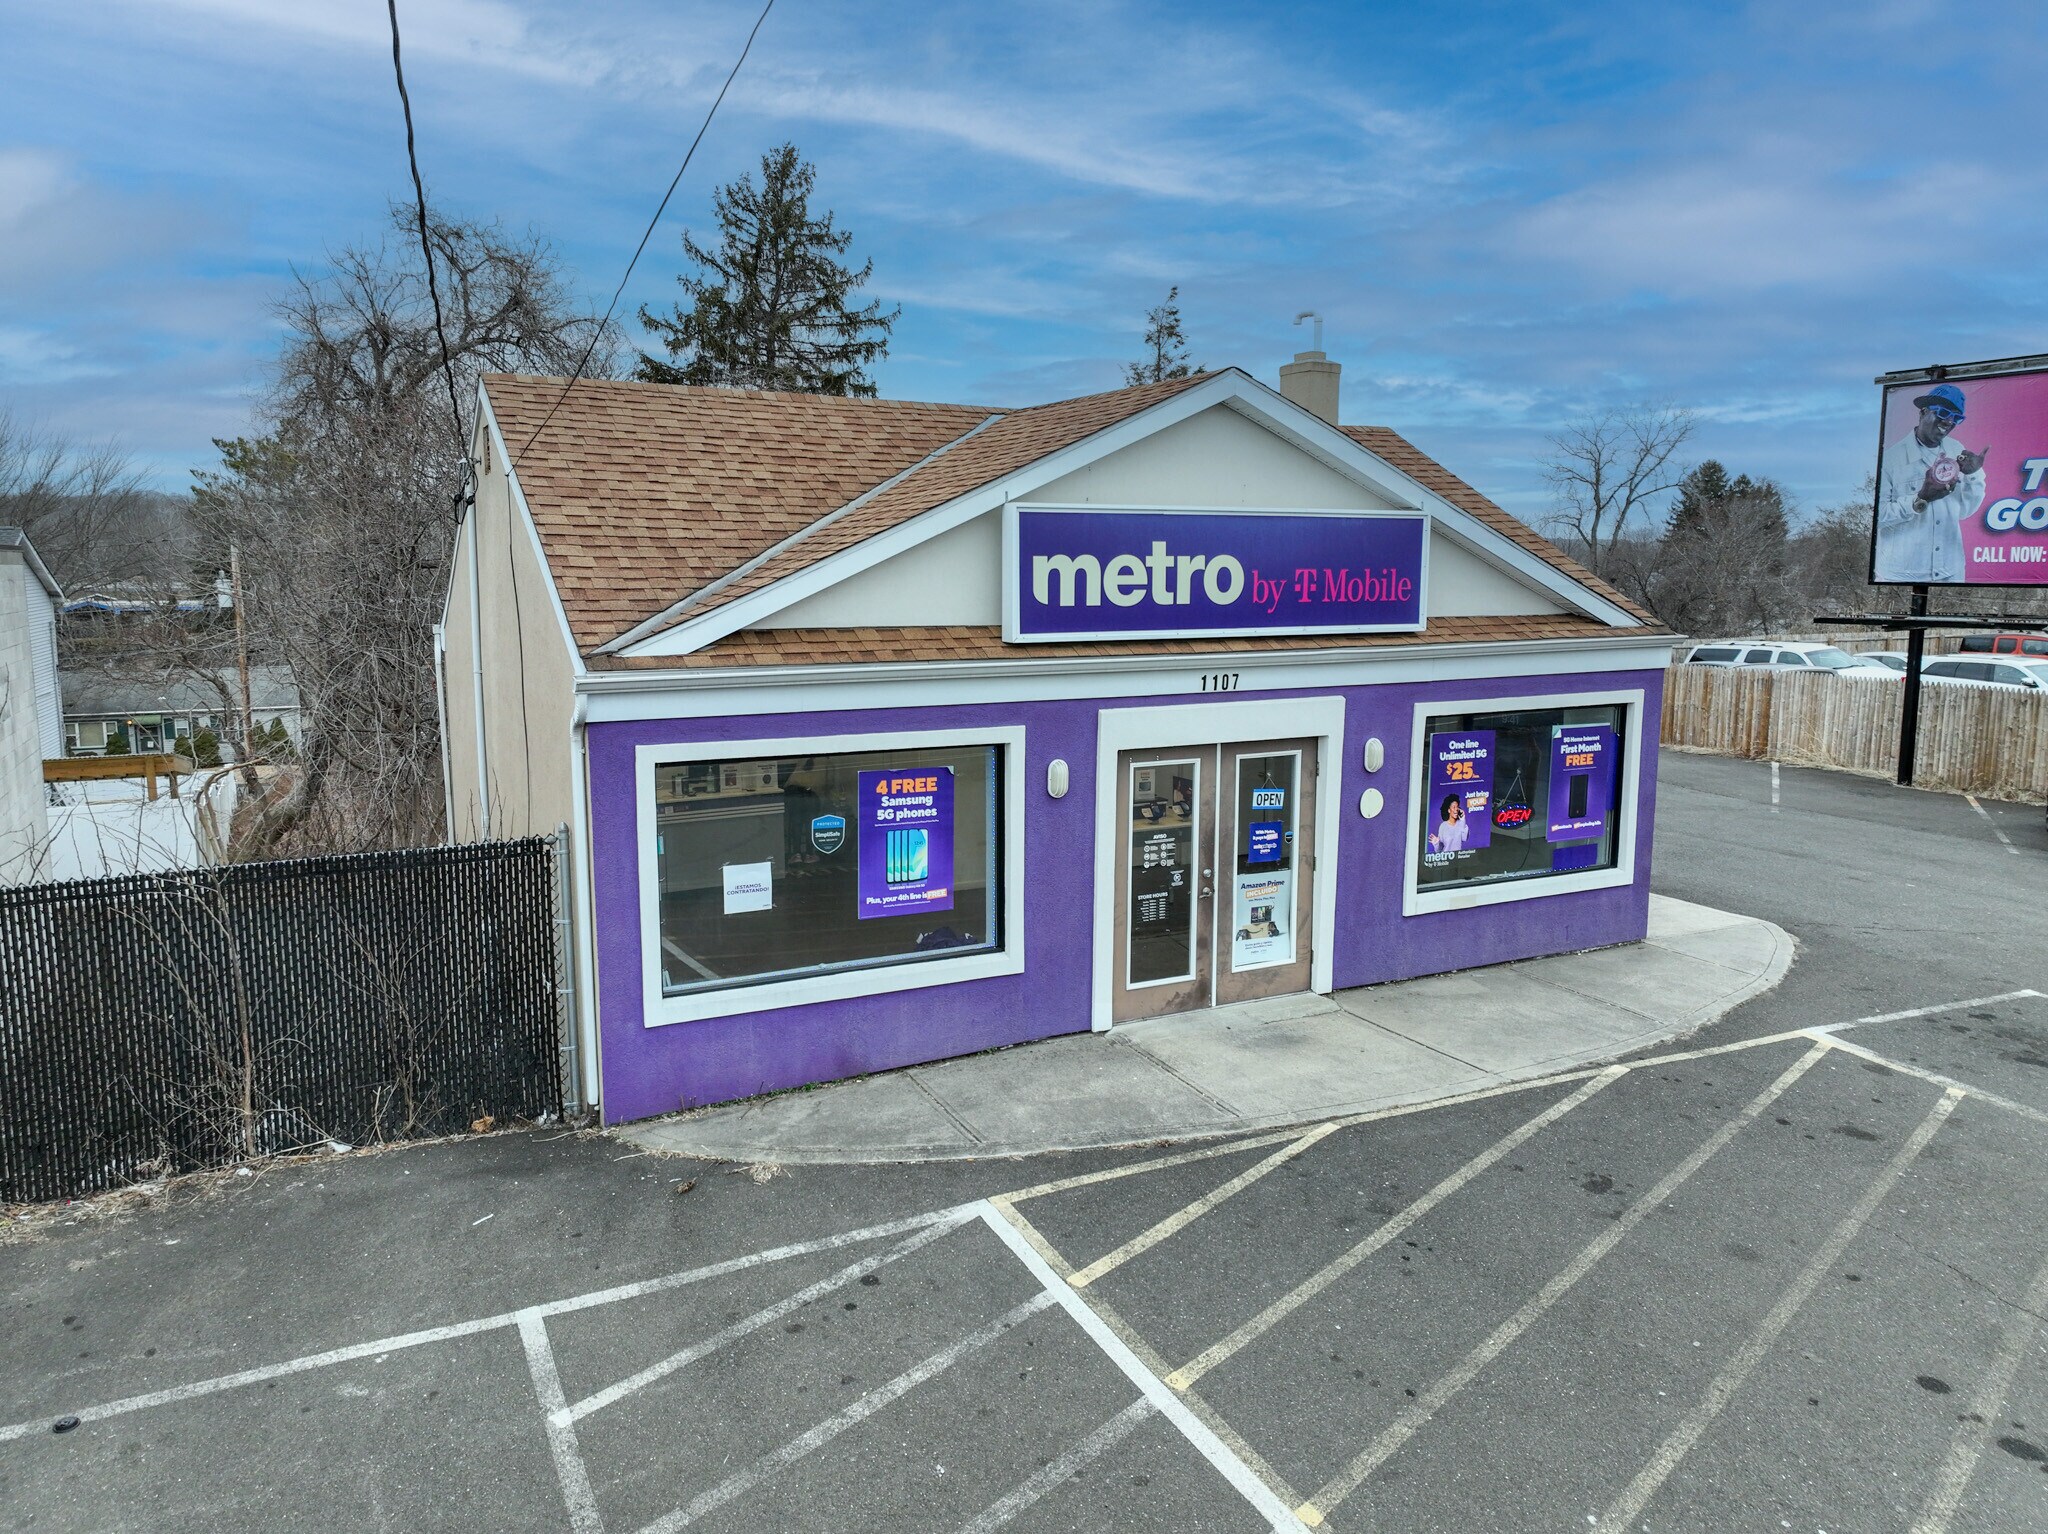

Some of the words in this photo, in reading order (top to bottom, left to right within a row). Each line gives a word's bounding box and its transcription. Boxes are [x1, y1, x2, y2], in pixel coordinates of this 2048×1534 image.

[1973, 546, 2006, 562] CALL
[2010, 546, 2047, 562] NOW:
[1032, 541, 1245, 607] metro
[1252, 570, 1287, 613] by
[1323, 568, 1412, 602] Mobile
[1201, 674, 1239, 692] 1107
[1449, 741, 1465, 749] One
[1466, 739, 1479, 748] line
[1561, 745, 1577, 754] First
[1578, 743, 1602, 752] Month
[1440, 751, 1475, 761] Unlimited
[1476, 749, 1487, 758] 5G
[1566, 753, 1594, 766] FREE
[1446, 761, 1473, 780] $25
[876, 780, 888, 795] 4
[891, 777, 938, 794] FREE
[881, 795, 933, 807] Samsung
[1256, 793, 1282, 806] OPEN
[876, 809, 895, 820] 5G
[896, 807, 938, 821] phones
[1496, 809, 1532, 823] OPEN
[1425, 851, 1455, 862] metro
[726, 887, 770, 896] CONTRATANDO!
[866, 897, 882, 905] Plus,
[883, 896, 898, 904] your
[898, 893, 909, 901] 4th
[910, 892, 921, 900] line
[928, 889, 946, 898] FREE
